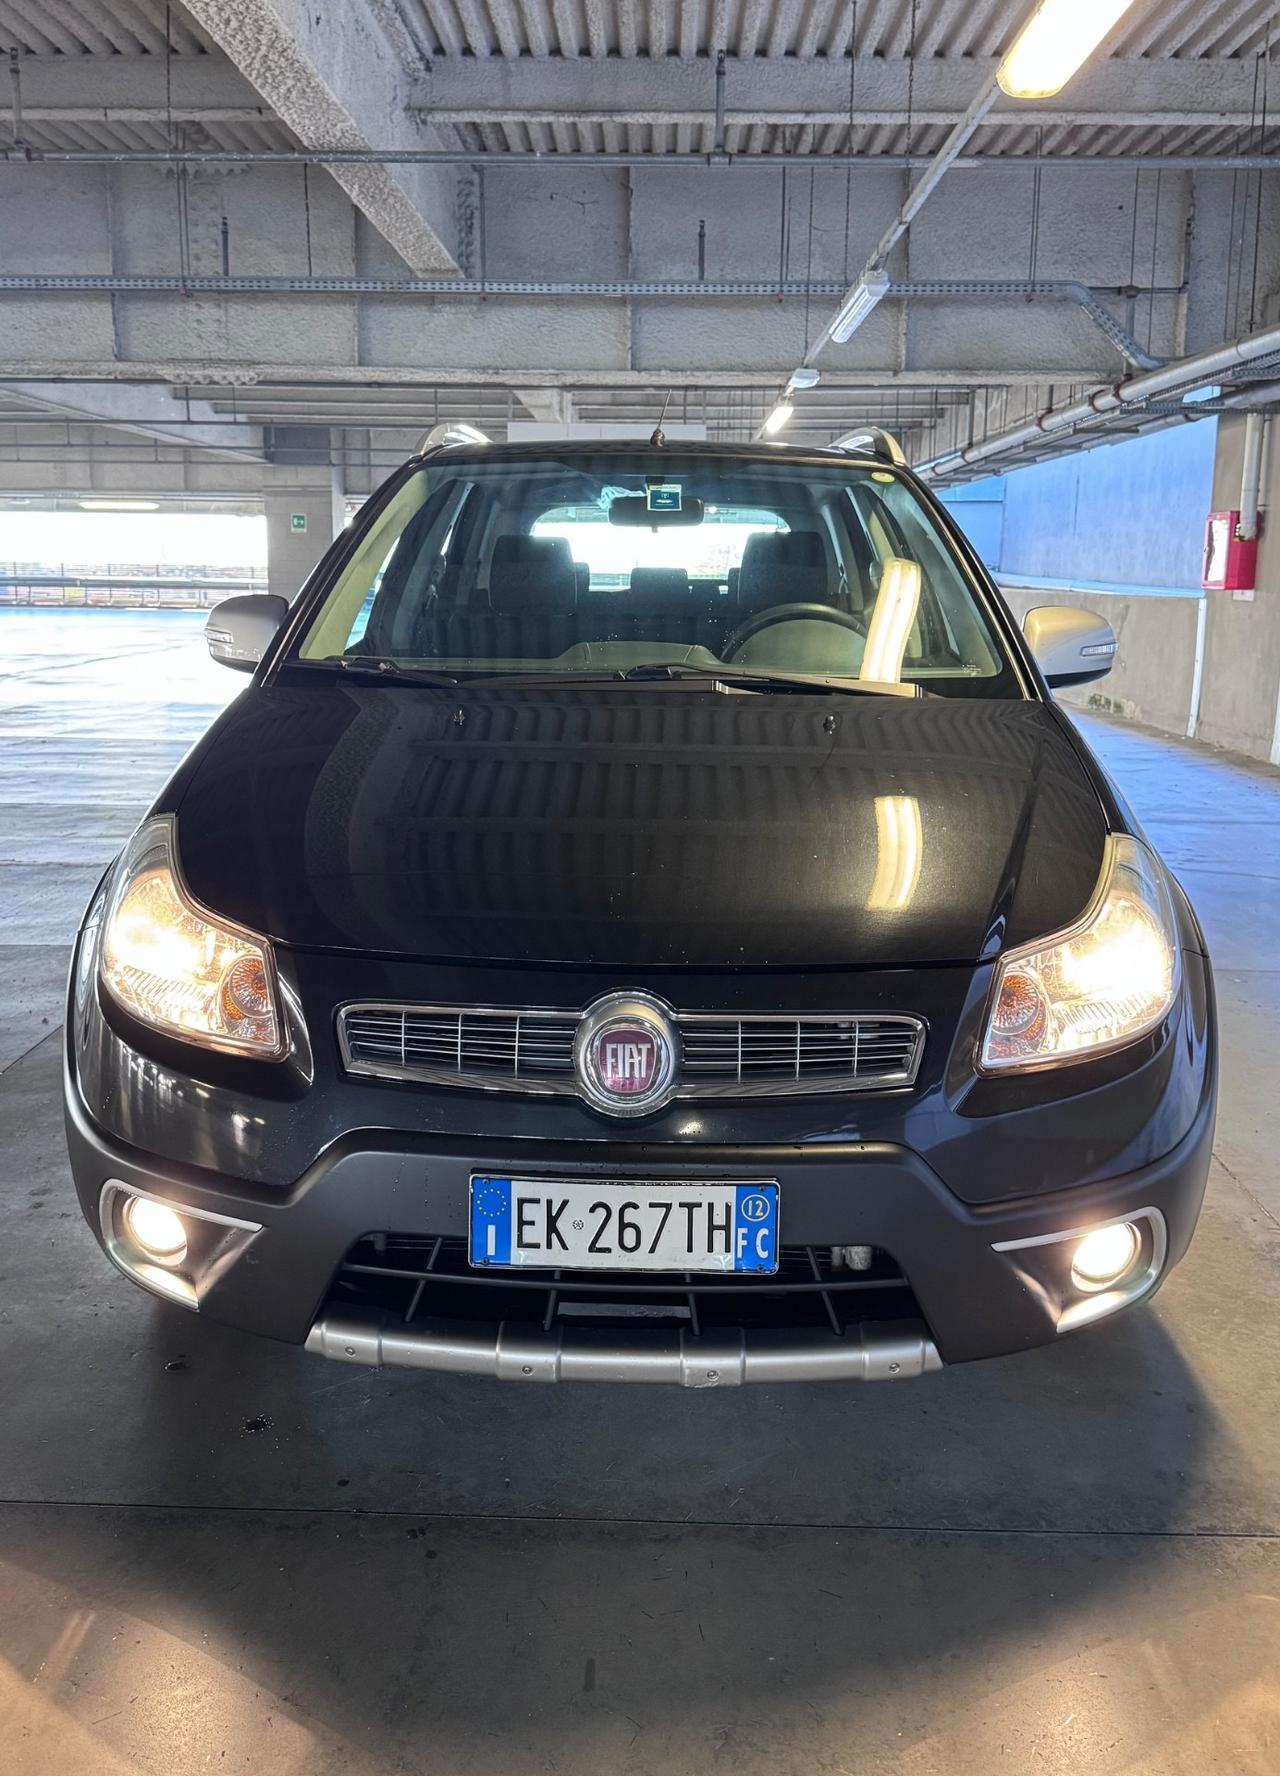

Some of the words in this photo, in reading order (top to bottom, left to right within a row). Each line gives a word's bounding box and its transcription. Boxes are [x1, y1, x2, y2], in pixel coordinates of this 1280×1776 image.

[606, 1043, 651, 1078] FIAT
[746, 1200, 764, 1216] 12
[487, 1224, 496, 1256] I
[516, 1197, 569, 1250] EK
[588, 1200, 732, 1254] 267TH
